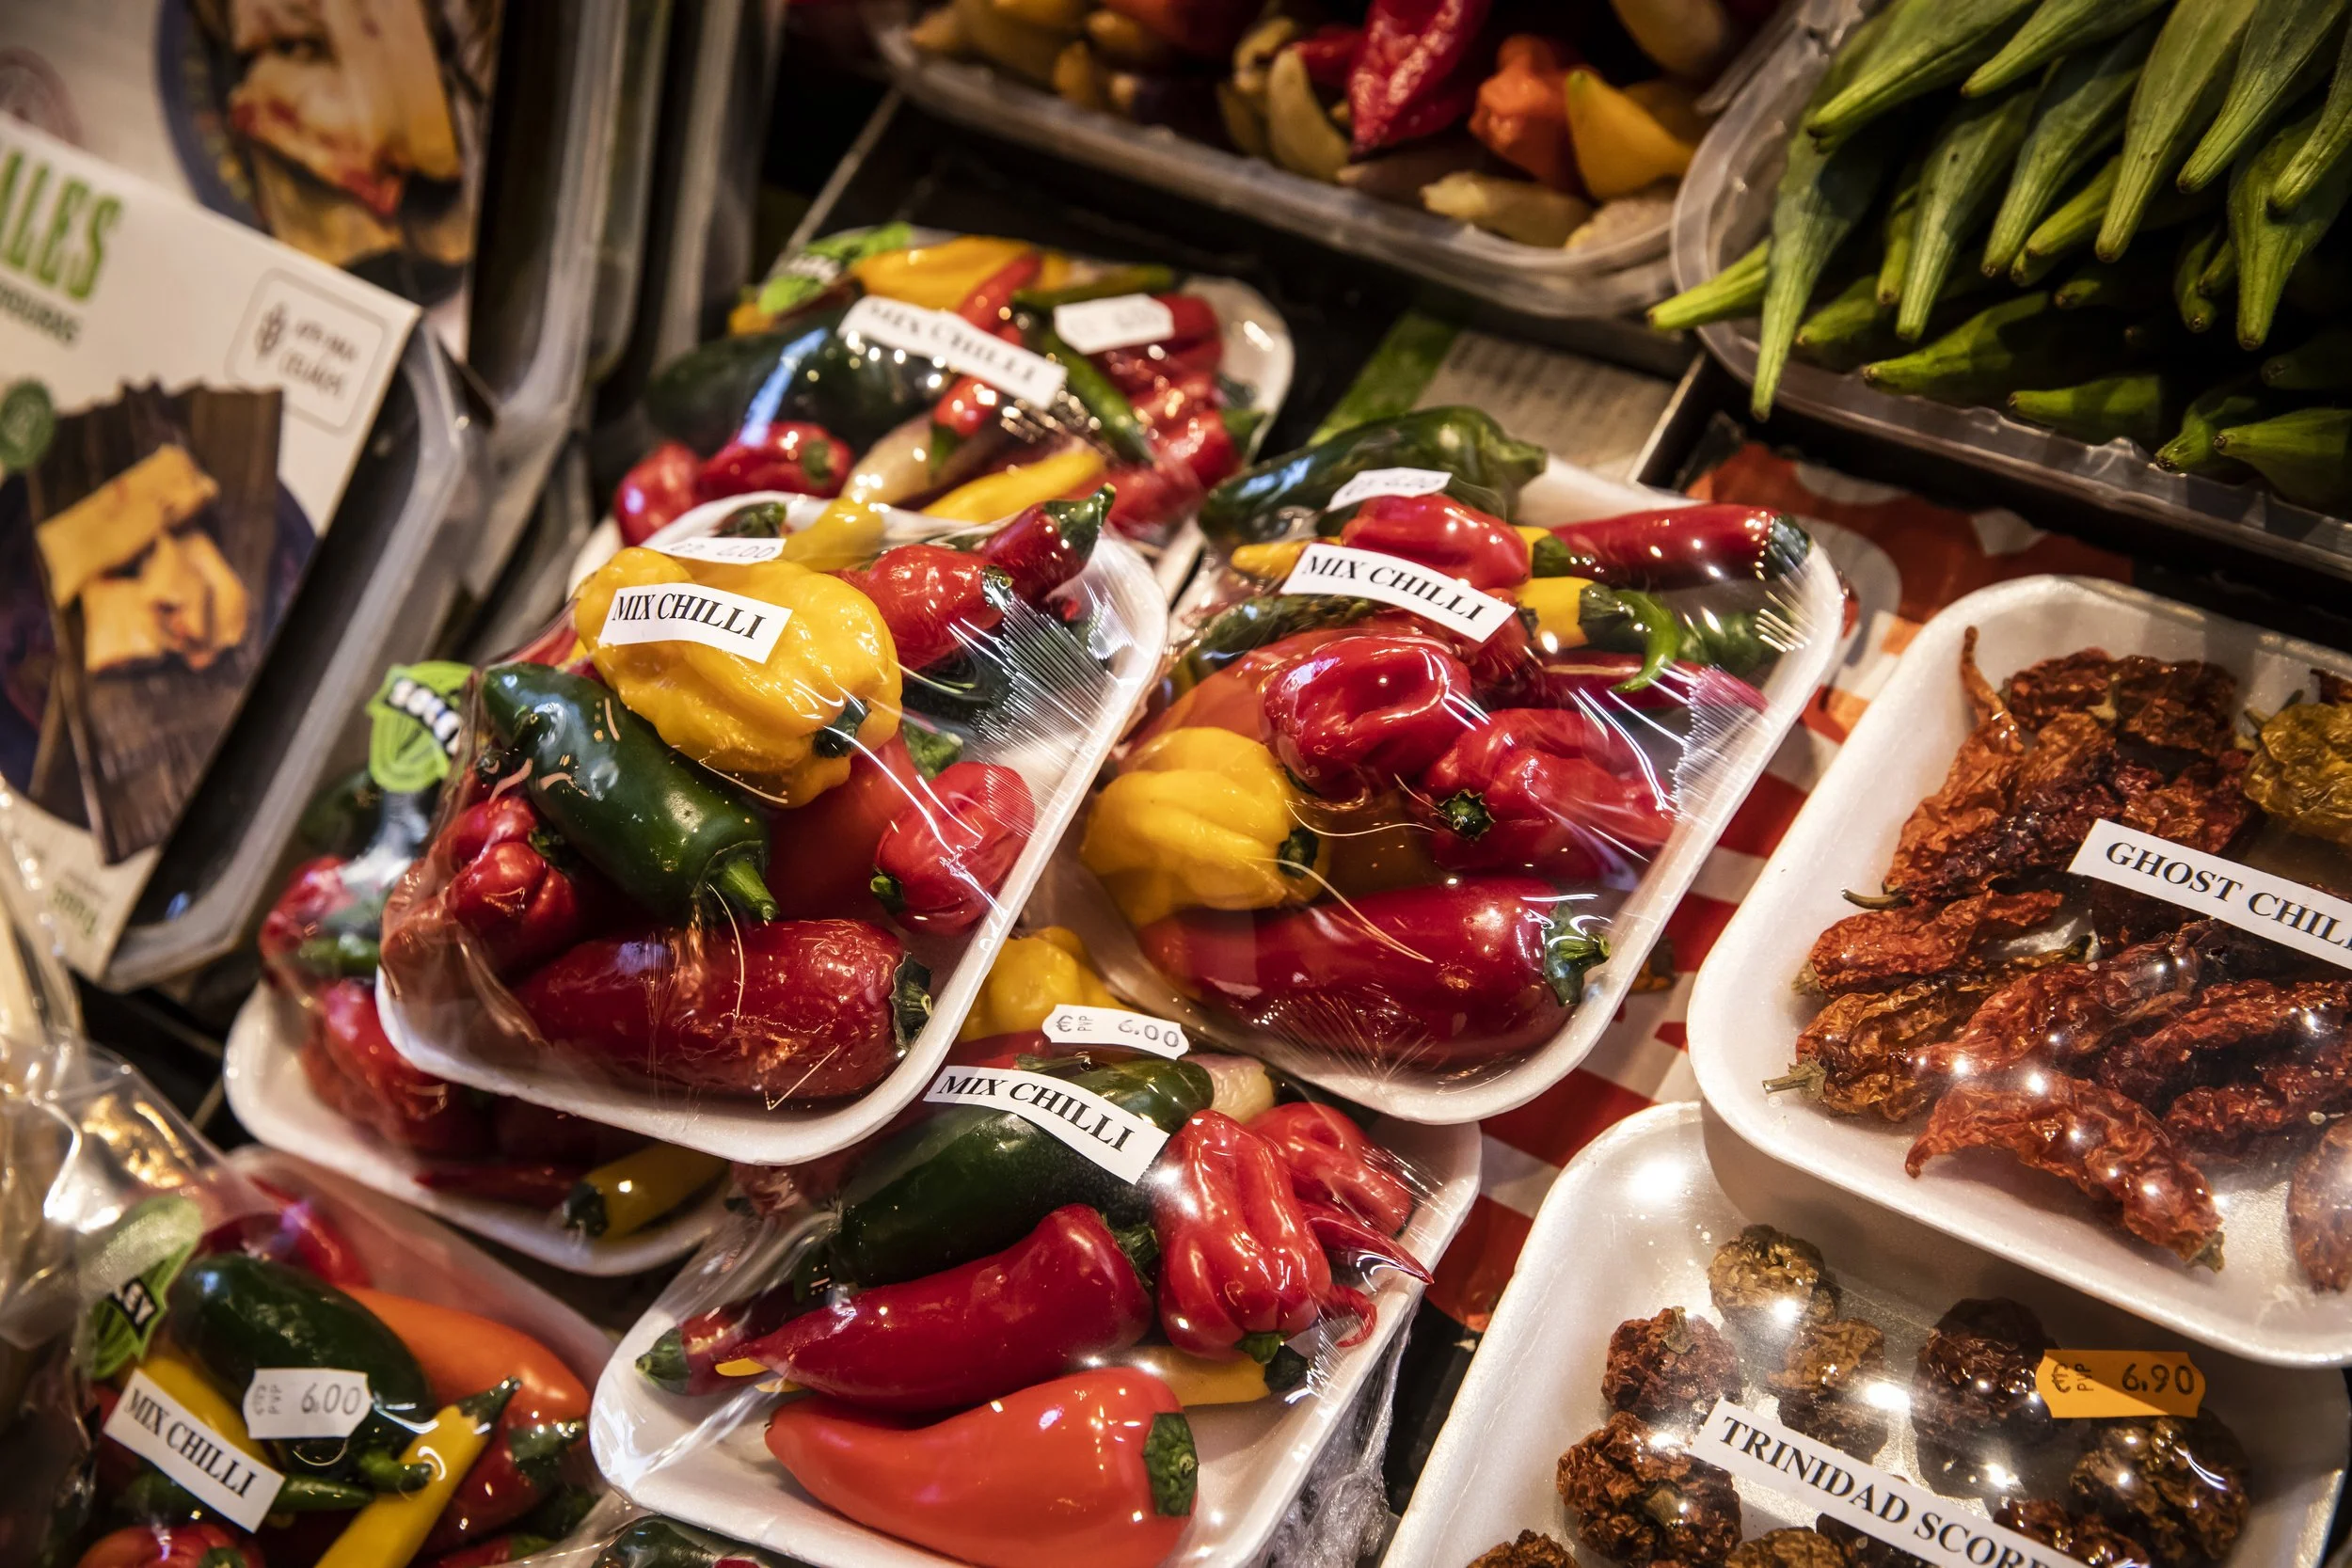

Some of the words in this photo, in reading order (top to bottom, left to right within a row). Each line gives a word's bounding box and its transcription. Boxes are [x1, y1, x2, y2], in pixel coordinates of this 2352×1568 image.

[612, 594, 656, 621] MIX
[657, 593, 766, 640] CHILLI
[1301, 555, 1366, 579] MIX
[1369, 565, 1486, 622] CHILLI
[2106, 842, 2244, 903] GHOST
[2248, 892, 2352, 951] CHIL
[1118, 1019, 1180, 1048] 6.00
[937, 1075, 1009, 1096] MIX
[1009, 1082, 1136, 1152] CHILLI
[123, 1387, 171, 1436] MIX
[166, 1420, 259, 1499] CHILLI
[1719, 1416, 1911, 1525] TRINIDAD
[1913, 1512, 2050, 1568] SCOR
